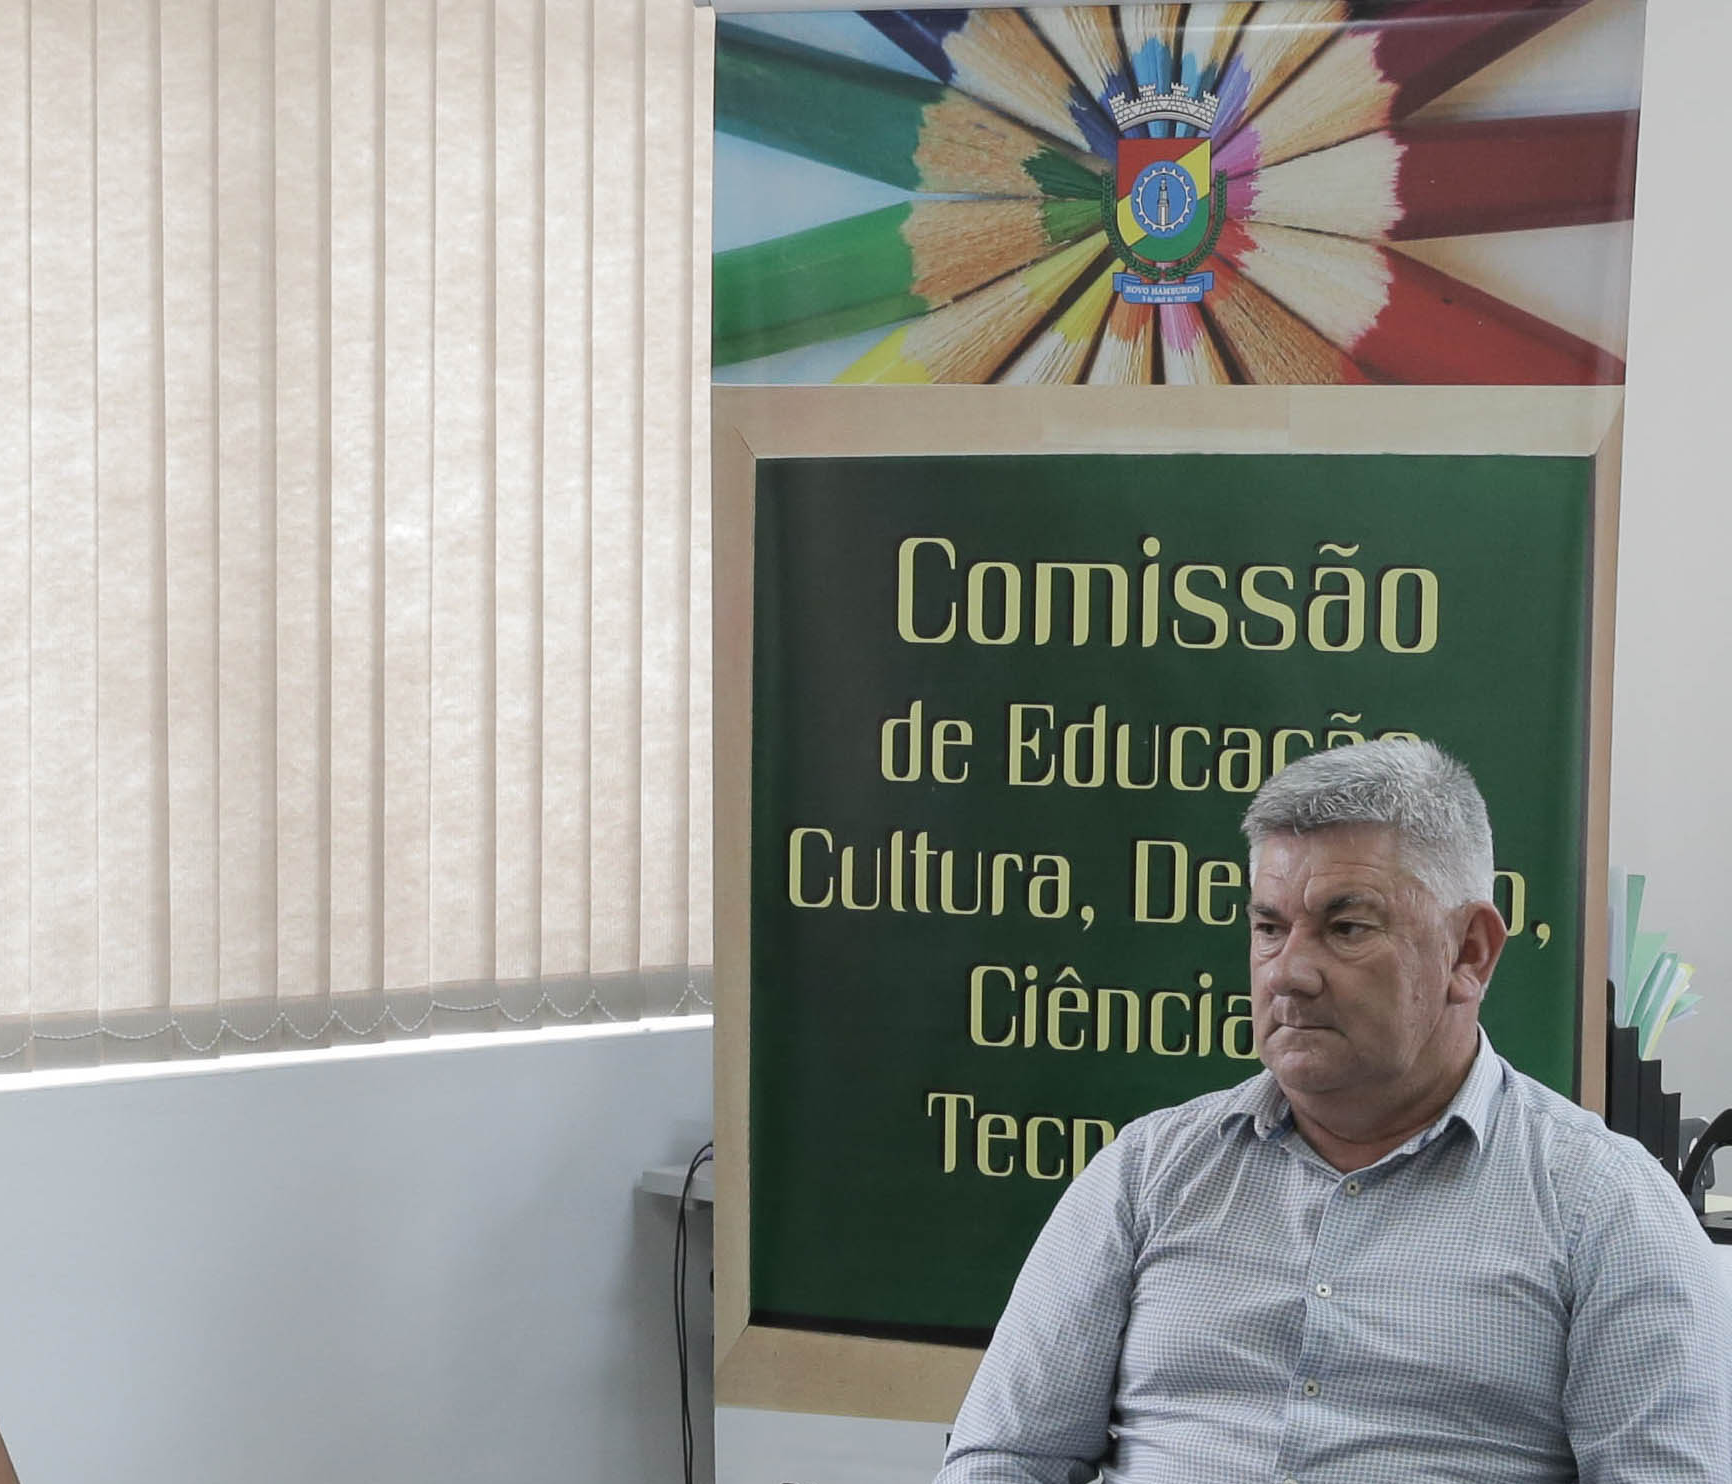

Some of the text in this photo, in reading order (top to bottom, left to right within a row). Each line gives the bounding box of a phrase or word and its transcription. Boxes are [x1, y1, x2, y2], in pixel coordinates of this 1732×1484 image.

[896, 537, 1439, 654] Comissão
[880, 701, 1421, 793] de Educa
[787, 828, 1096, 931] Cultura,
[969, 964, 1260, 1060] Ciência
